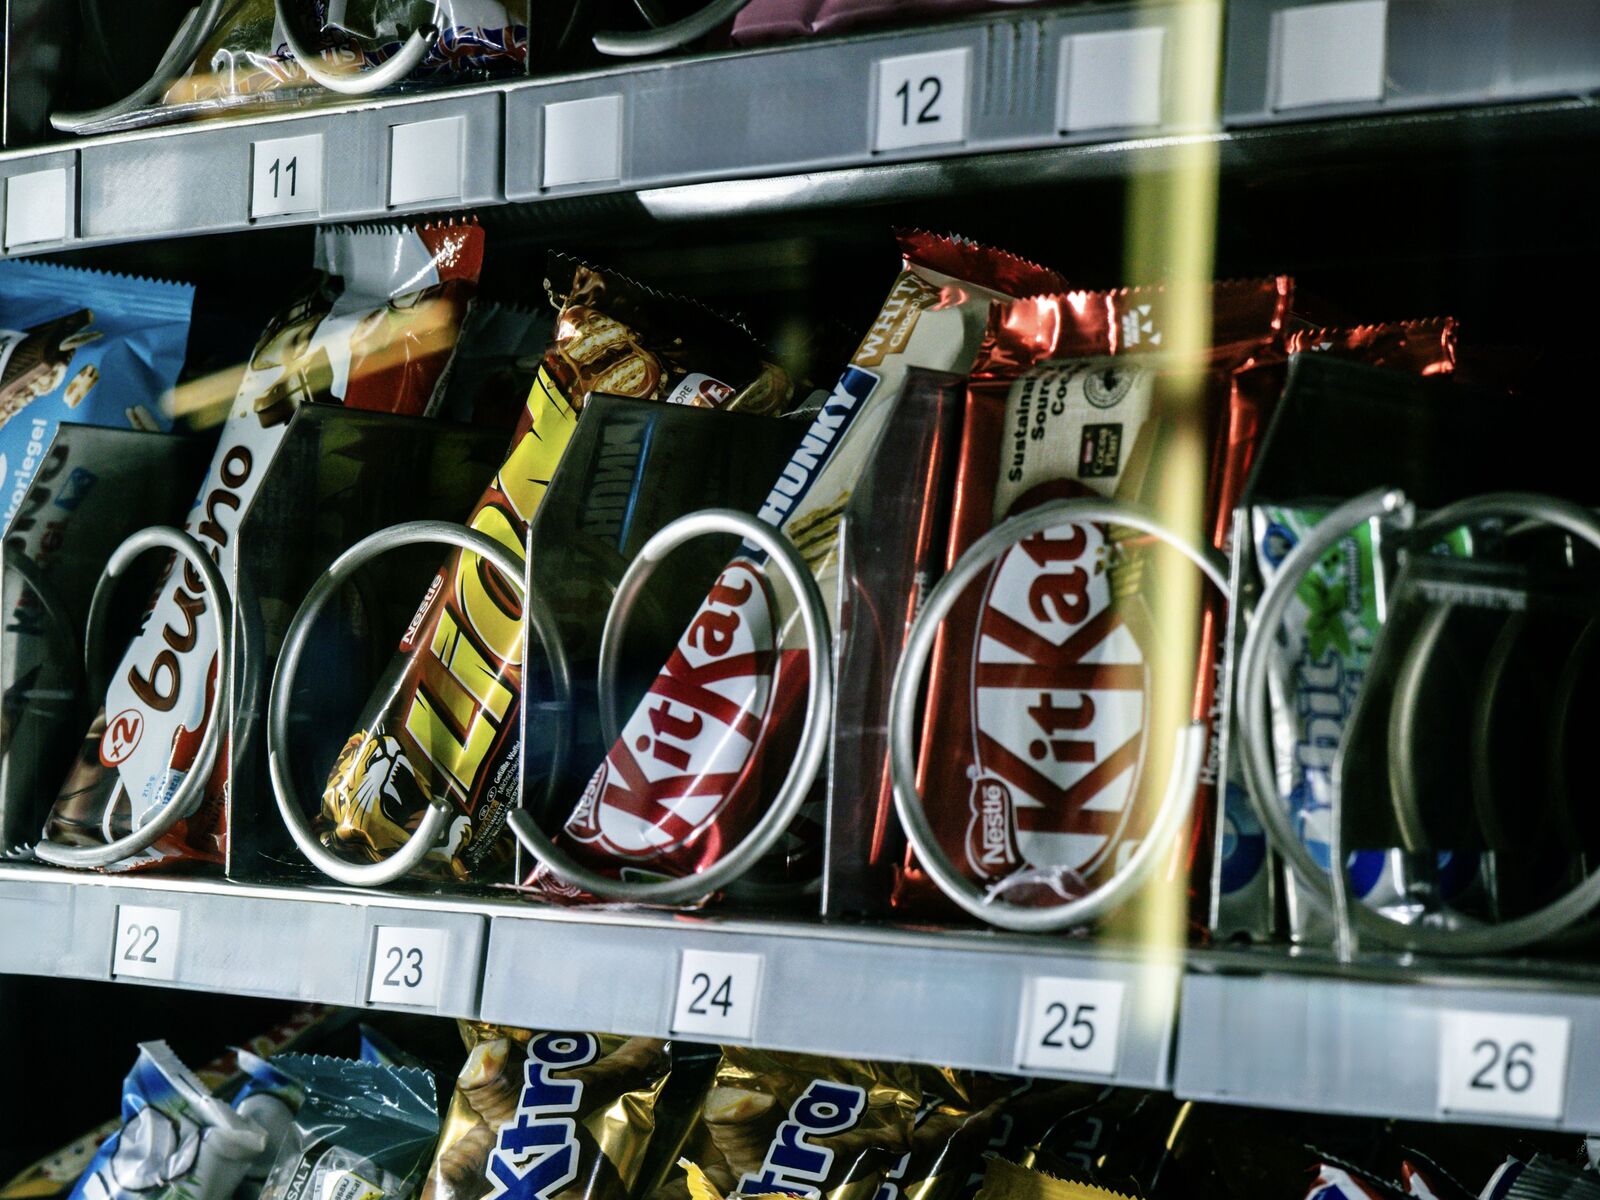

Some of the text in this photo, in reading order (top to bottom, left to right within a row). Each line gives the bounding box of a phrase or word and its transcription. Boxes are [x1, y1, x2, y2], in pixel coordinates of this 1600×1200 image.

[896, 76, 943, 126] 12
[269, 156, 297, 199] 11
[128, 446, 252, 711] bueno
[405, 505, 527, 803] LIO
[977, 523, 1144, 834] KitKat
[603, 574, 764, 842] KitKat
[123, 926, 160, 963] 22
[383, 947, 424, 988] 23
[688, 973, 734, 1017] 24
[1041, 1002, 1097, 1050] 25
[1469, 1040, 1535, 1093] 26
